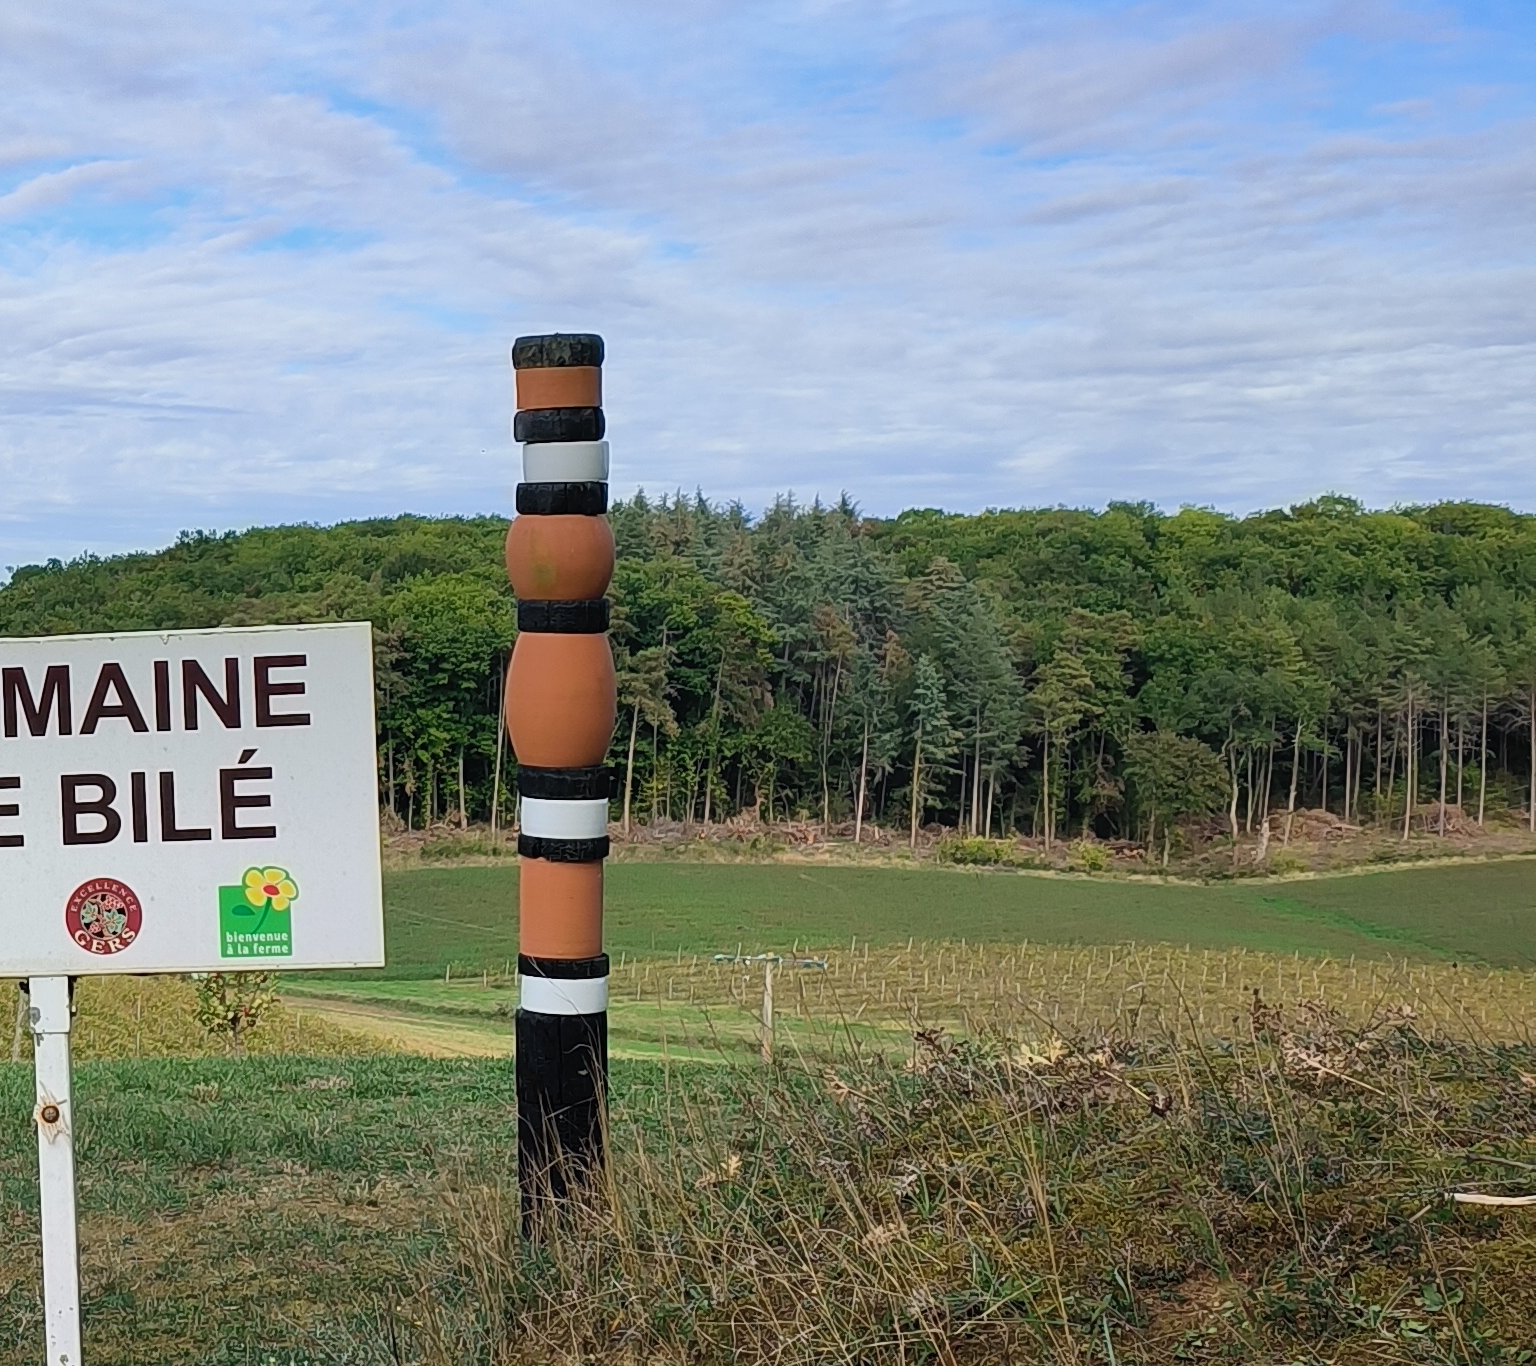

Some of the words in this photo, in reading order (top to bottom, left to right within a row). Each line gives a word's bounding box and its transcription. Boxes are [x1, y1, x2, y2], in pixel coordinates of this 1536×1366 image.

[60, 748, 277, 846] BILÉ
[70, 881, 138, 912] EXCELLENCE
[74, 927, 136, 953] GERS
[225, 931, 289, 942] bienvenue
[226, 943, 234, 955] à
[237, 943, 249, 955] la
[253, 943, 289, 954] ferme
